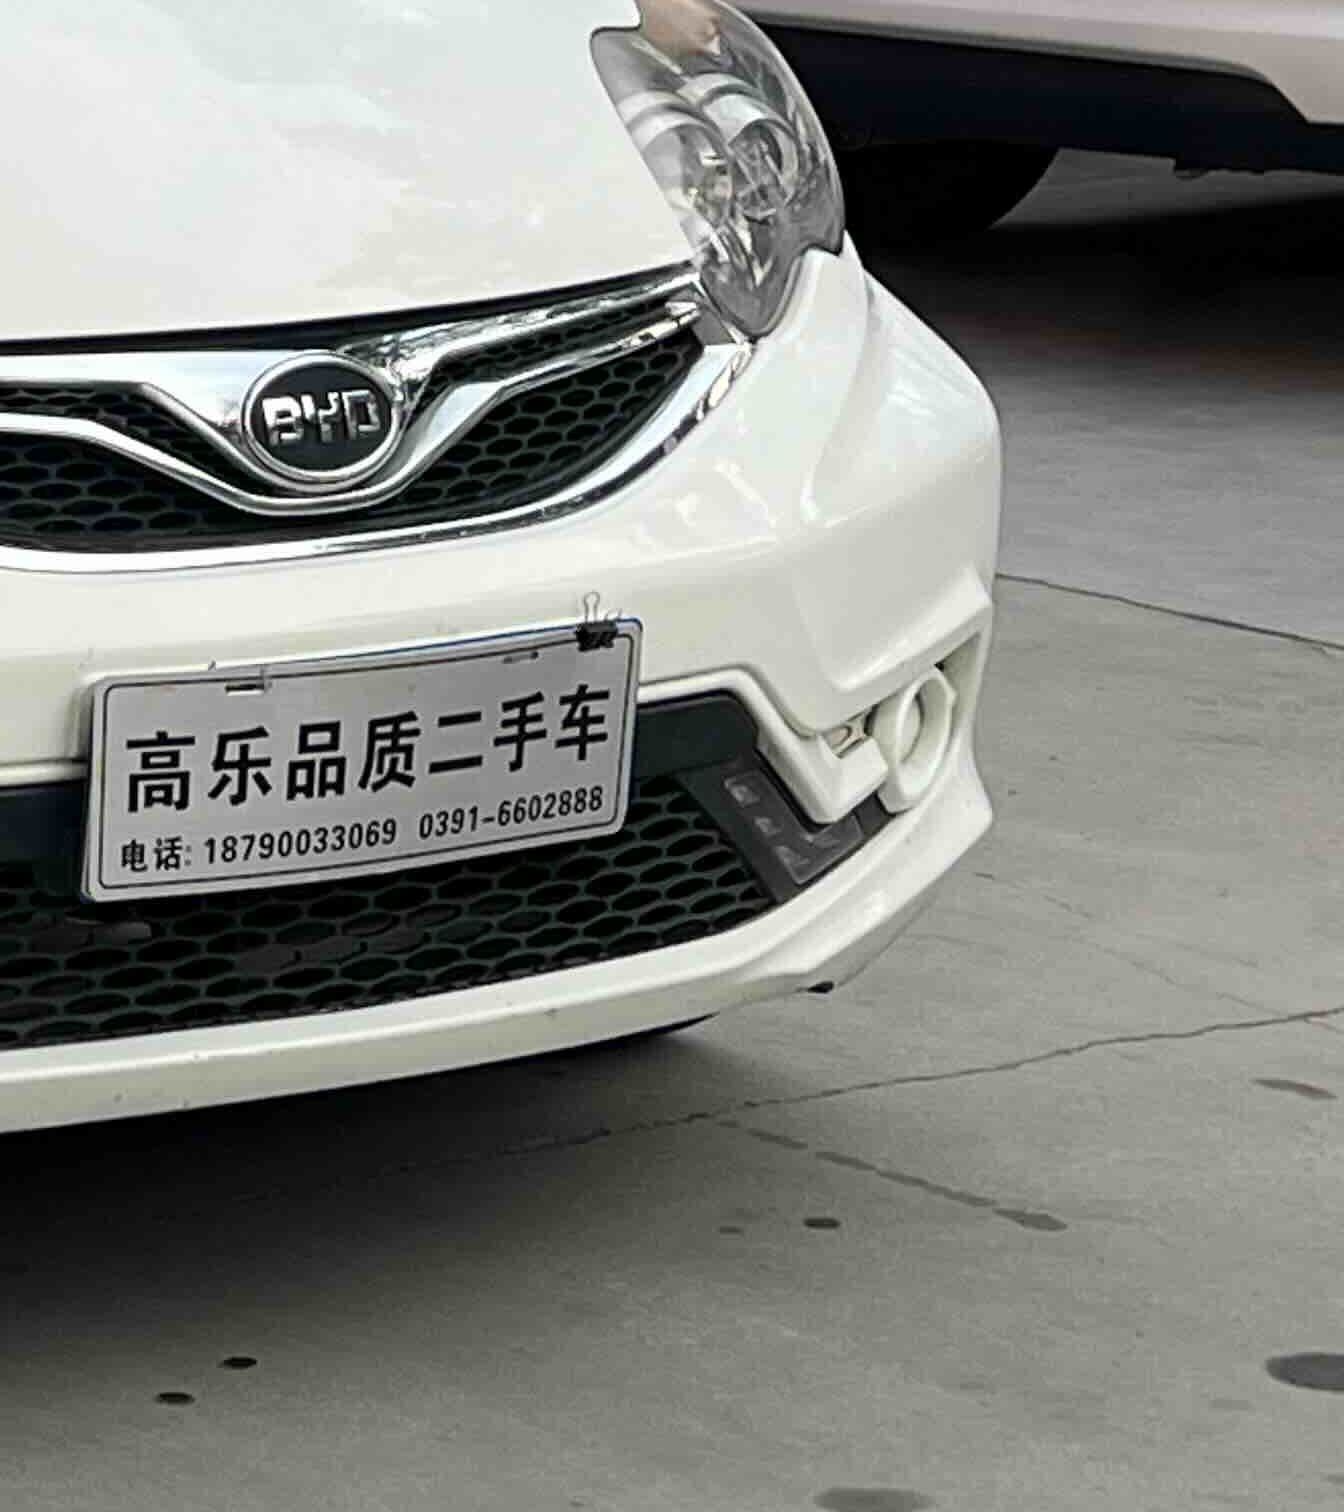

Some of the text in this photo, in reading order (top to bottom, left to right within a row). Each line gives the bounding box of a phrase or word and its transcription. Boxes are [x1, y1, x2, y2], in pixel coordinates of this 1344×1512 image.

[261, 389, 382, 447] BYD
[125, 684, 611, 814] 高乐品质二手车
[120, 785, 604, 873] 电话: 18790033069 0391-6602888
